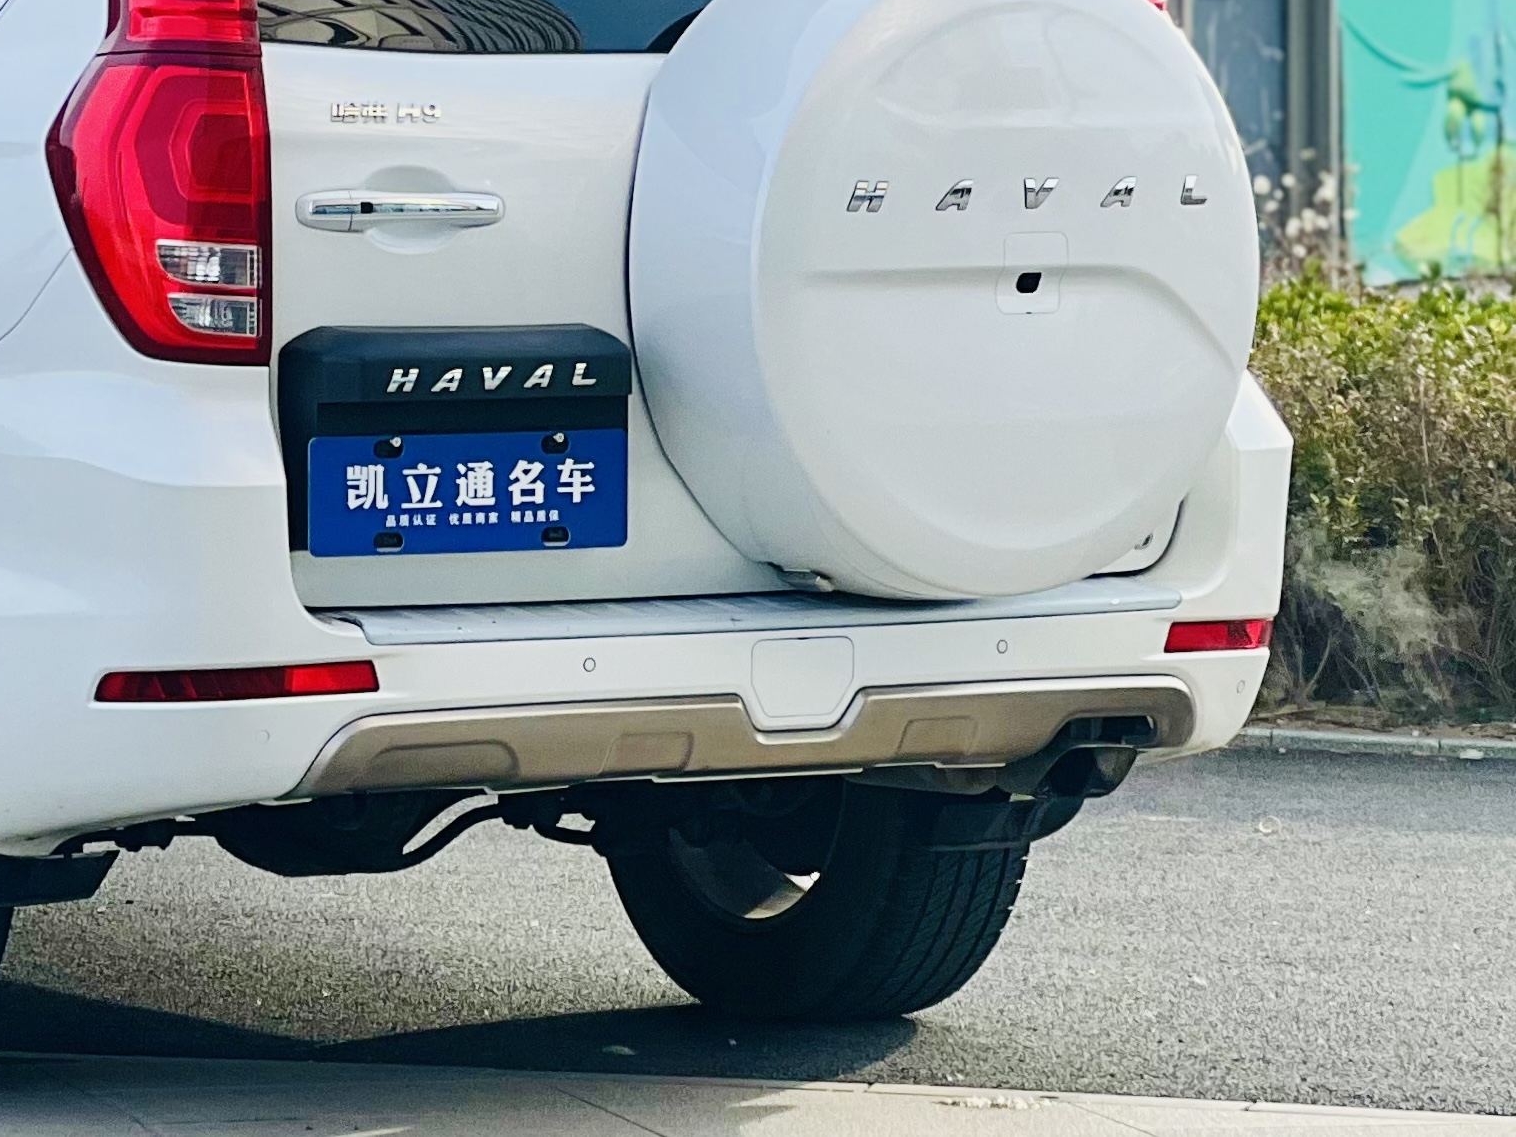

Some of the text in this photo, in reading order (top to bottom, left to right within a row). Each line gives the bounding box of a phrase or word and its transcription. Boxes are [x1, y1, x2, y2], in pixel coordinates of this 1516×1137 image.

[846, 175, 1207, 212] HAVAL
[387, 363, 597, 393] HAVAL
[346, 458, 595, 509] 凯立通名车
